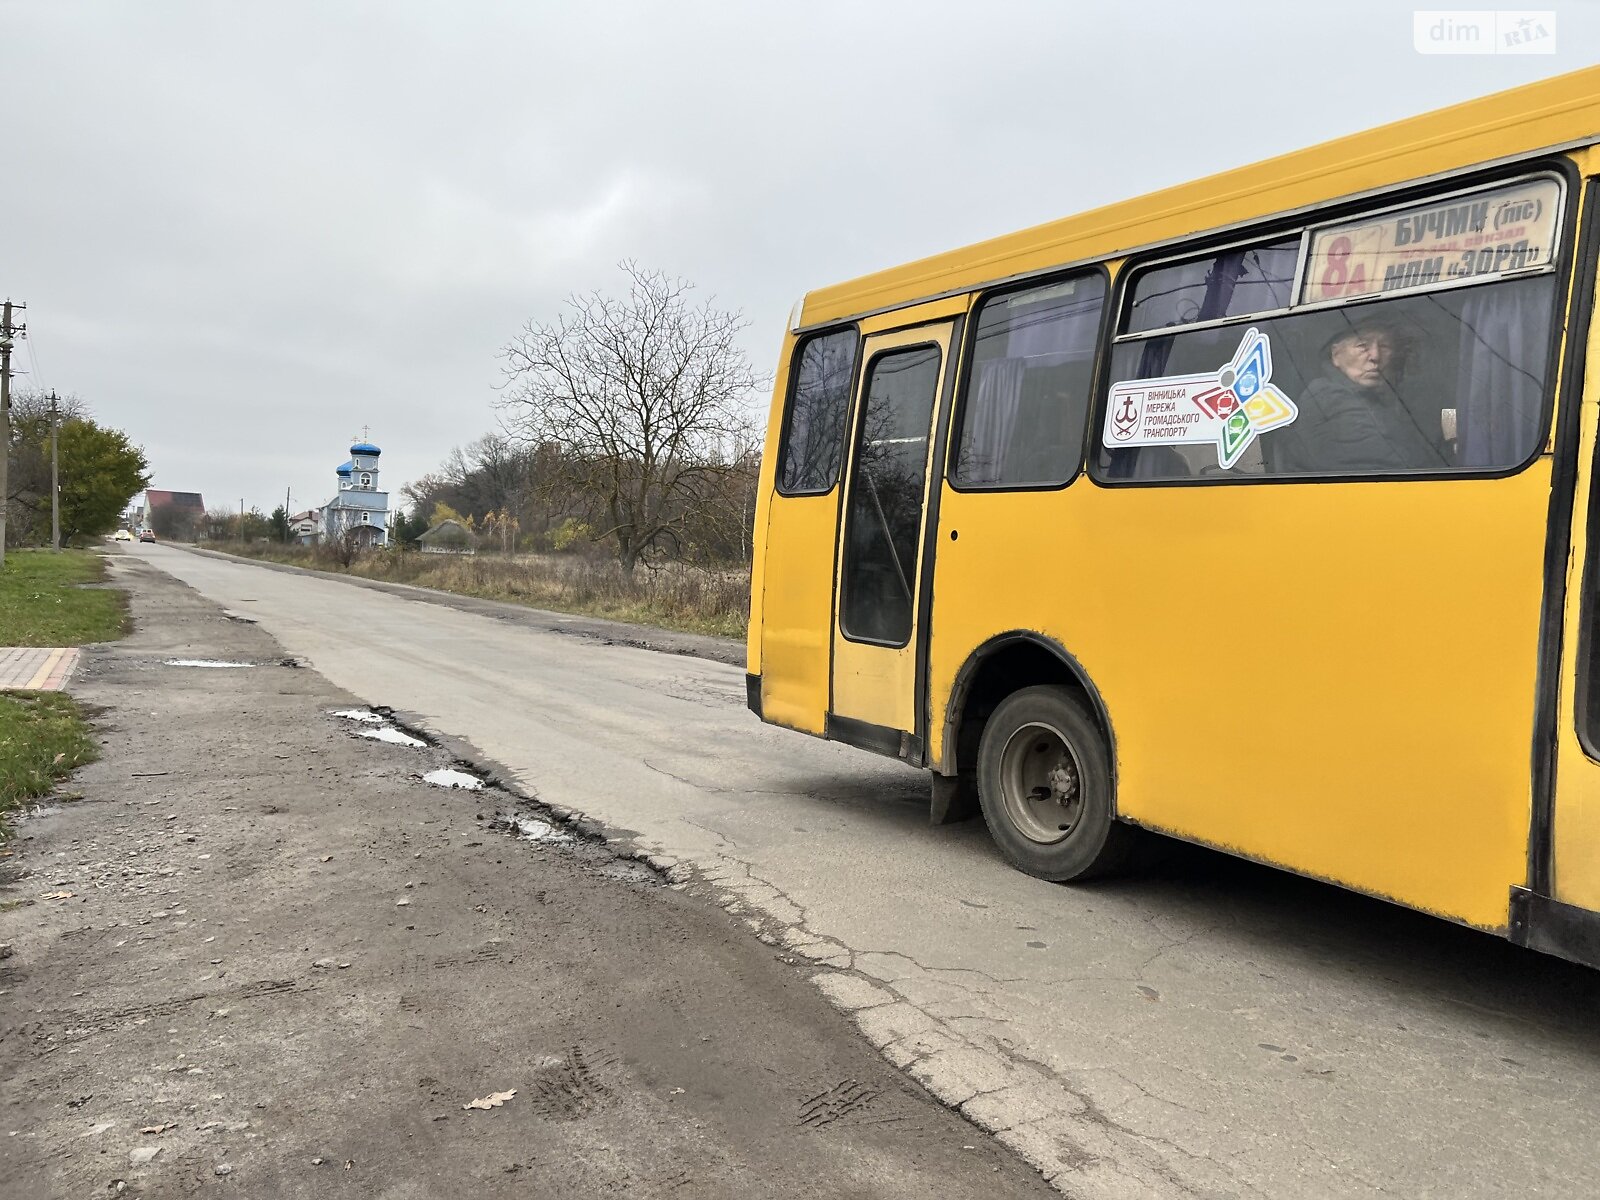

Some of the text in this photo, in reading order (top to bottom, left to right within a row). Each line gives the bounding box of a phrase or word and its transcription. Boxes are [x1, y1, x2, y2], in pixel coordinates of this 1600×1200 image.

[1394, 201, 1489, 247] БУЧМИ
[1148, 389, 1185, 400] ВІННИЦЬКА
[1145, 402, 1176, 413] МЕРЕЖА
[1144, 413, 1200, 426] ГРОМАДСЬКОГО
[1143, 426, 1188, 438] ТРАНСПОРТУ
